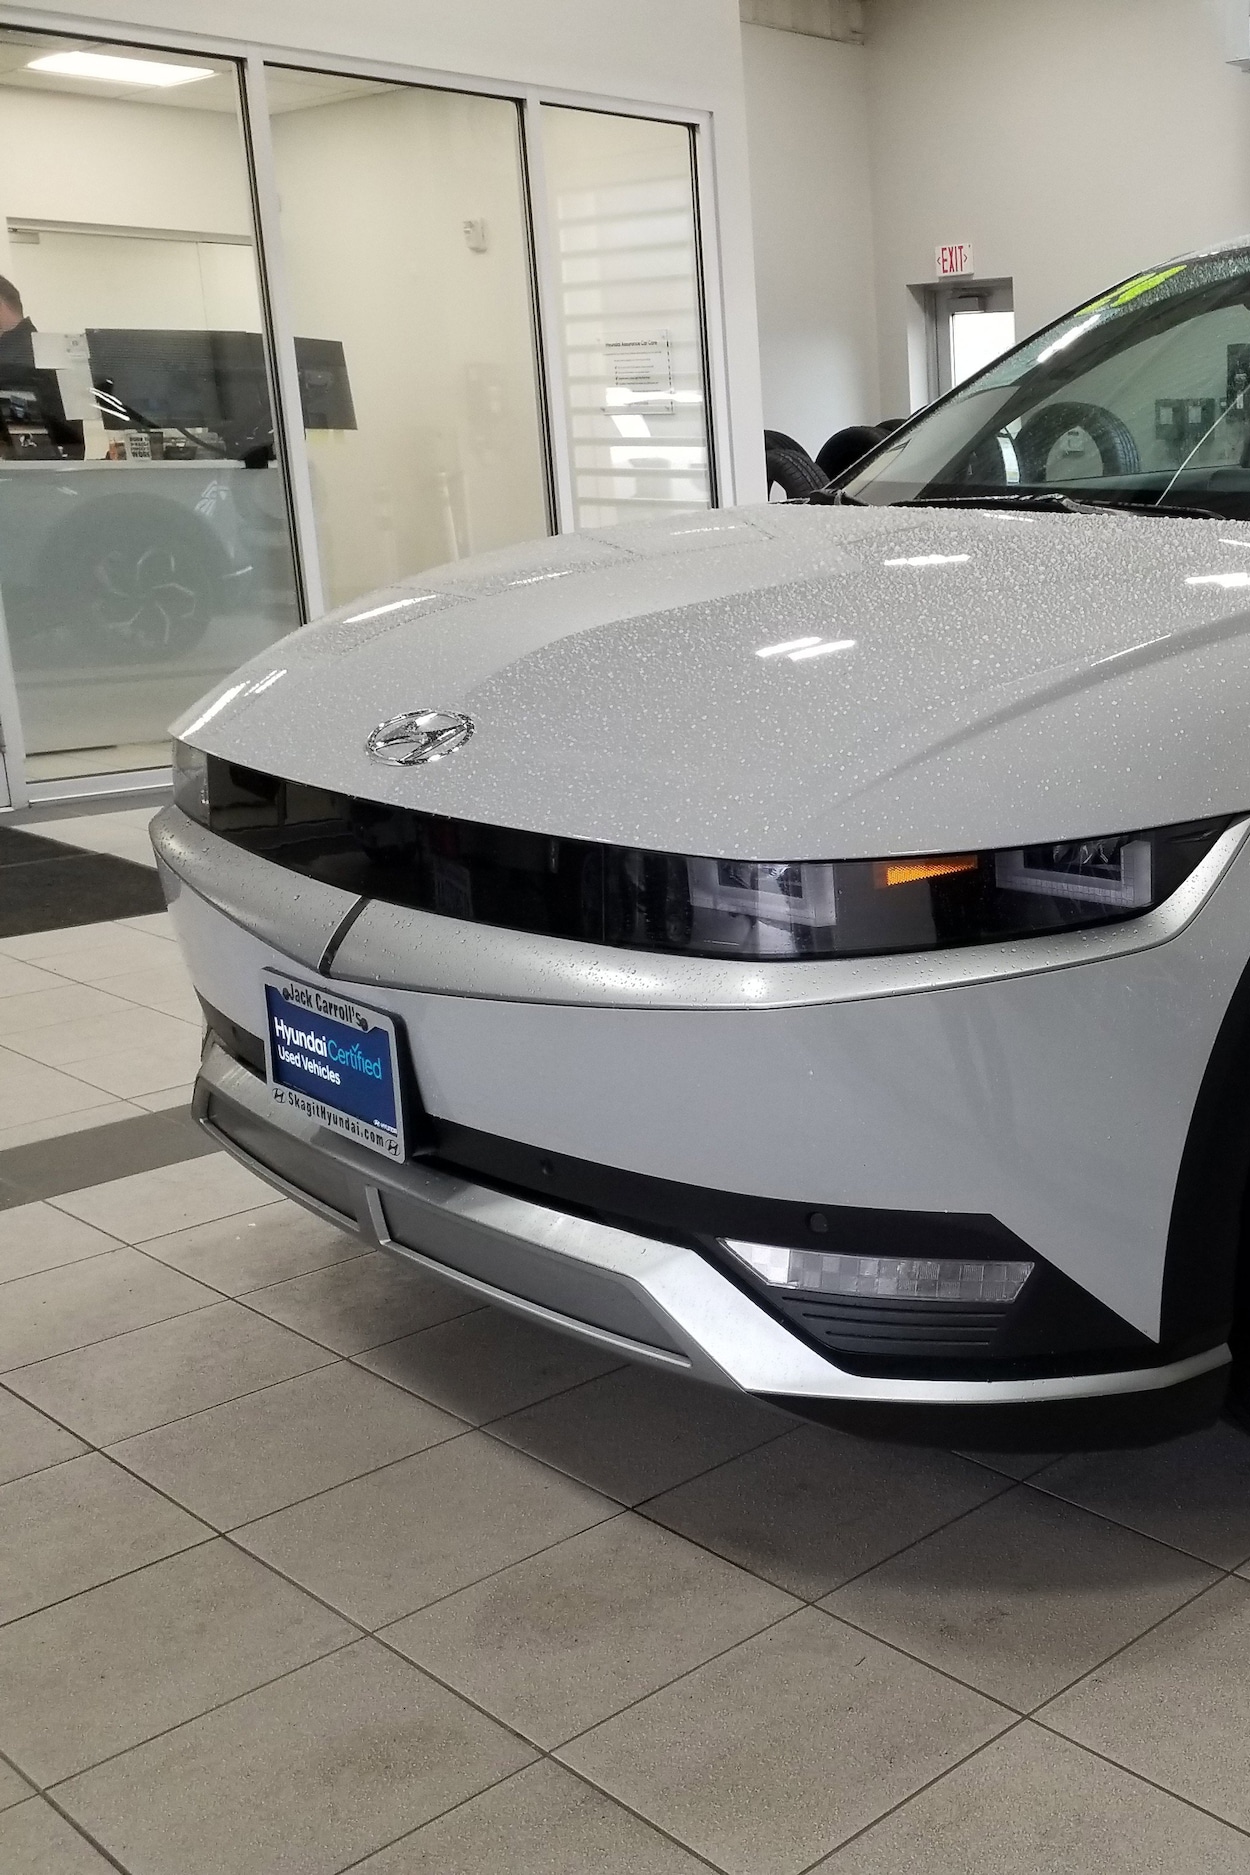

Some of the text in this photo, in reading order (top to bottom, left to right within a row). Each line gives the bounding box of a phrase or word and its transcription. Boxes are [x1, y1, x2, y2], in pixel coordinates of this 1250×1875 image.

[941, 245, 964, 273] EXIT
[289, 983, 363, 1027] Jack Carroll's
[274, 1016, 382, 1080] Hyundai Certified
[278, 1044, 341, 1085] Used Vehicles
[288, 1091, 384, 1148] SkagitHyundai.com
